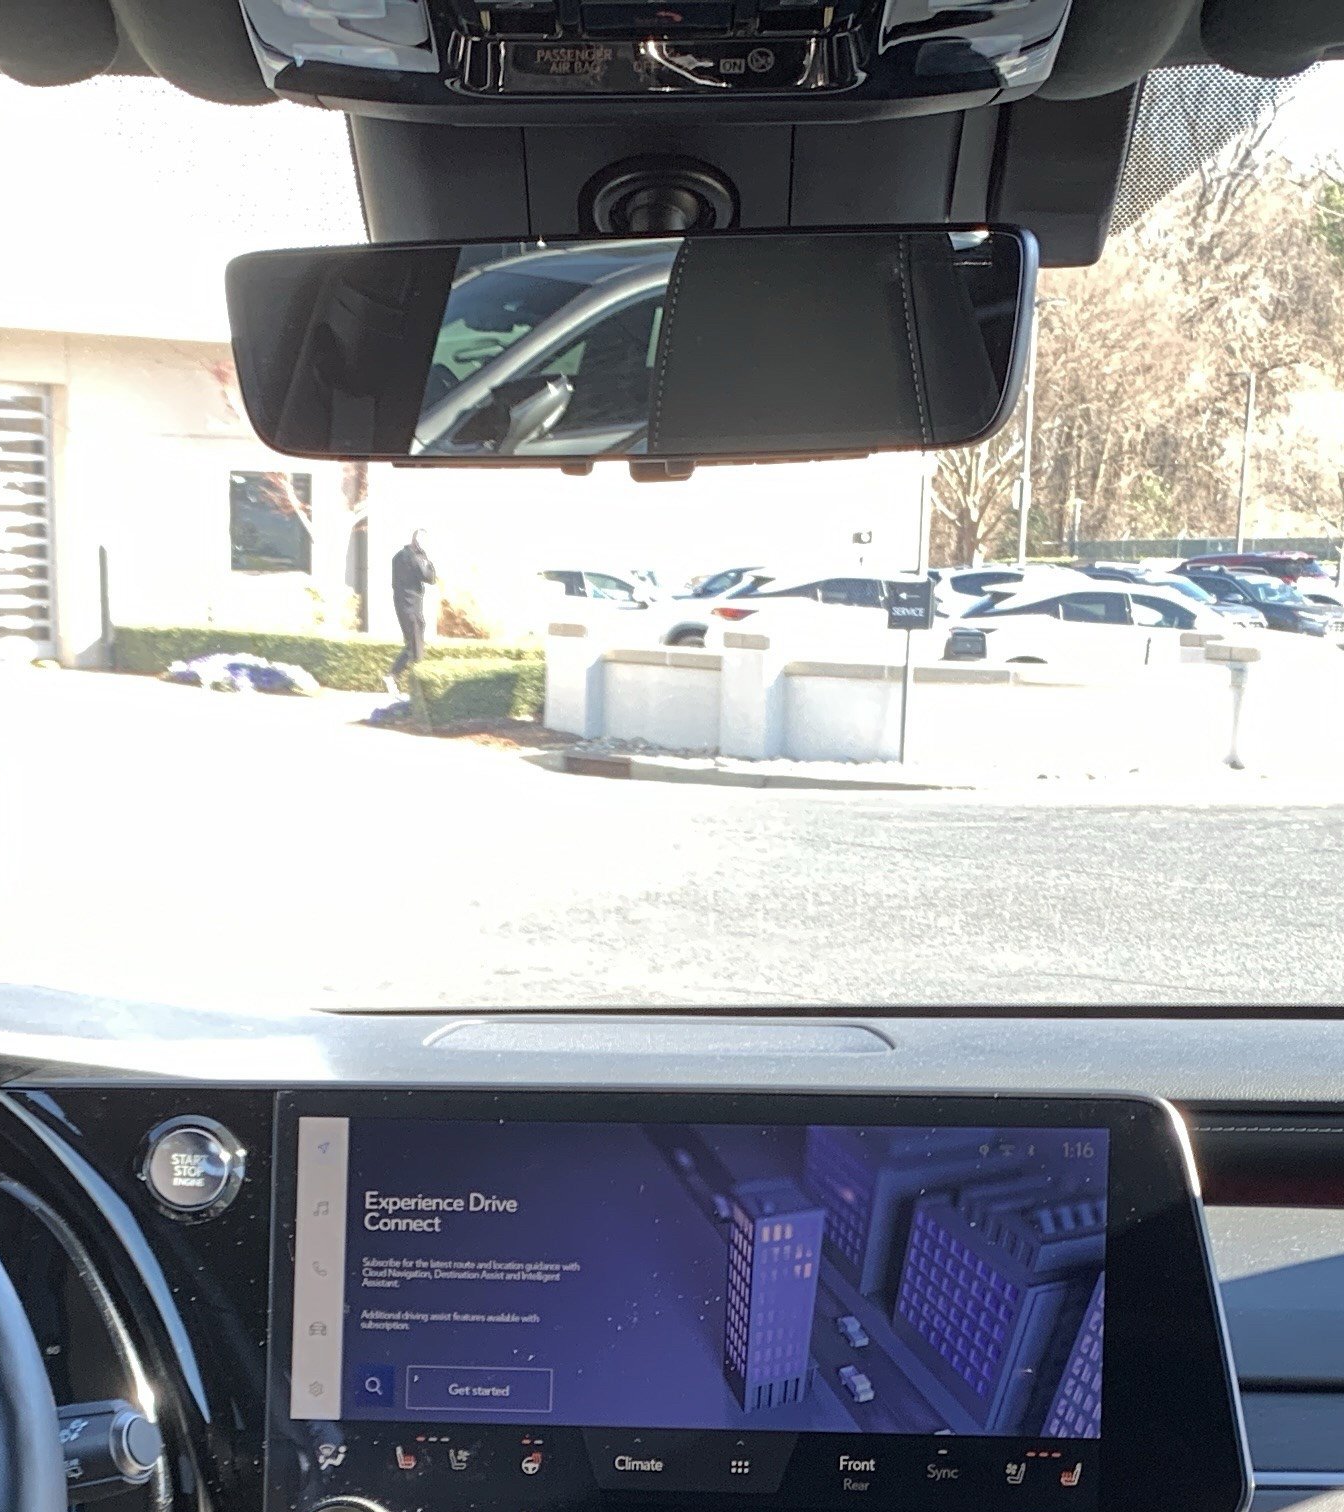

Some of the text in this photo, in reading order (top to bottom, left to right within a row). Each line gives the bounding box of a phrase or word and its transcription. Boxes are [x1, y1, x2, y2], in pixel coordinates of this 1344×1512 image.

[550, 61, 571, 74] AIR
[721, 60, 743, 73] ON
[1062, 1141, 1095, 1159] 1:16
[173, 1165, 205, 1177] STOP
[364, 1190, 519, 1214] Experience Drive
[363, 1212, 442, 1233] Connect
[361, 1257, 581, 1273] Subscribe for the latest route and location guidance with
[361, 1267, 387, 1278] Cloud
[434, 1268, 480, 1279] Destination
[480, 1269, 505, 1280] Assist
[505, 1271, 521, 1281] and
[521, 1271, 561, 1283] Intelligent
[360, 1309, 541, 1323] Additional driving assist features available with
[448, 1383, 511, 1398] Get started
[614, 1455, 664, 1473] Climate
[839, 1455, 876, 1473] Front
[926, 1463, 960, 1482] Sync
[843, 1477, 871, 1492] Rear
